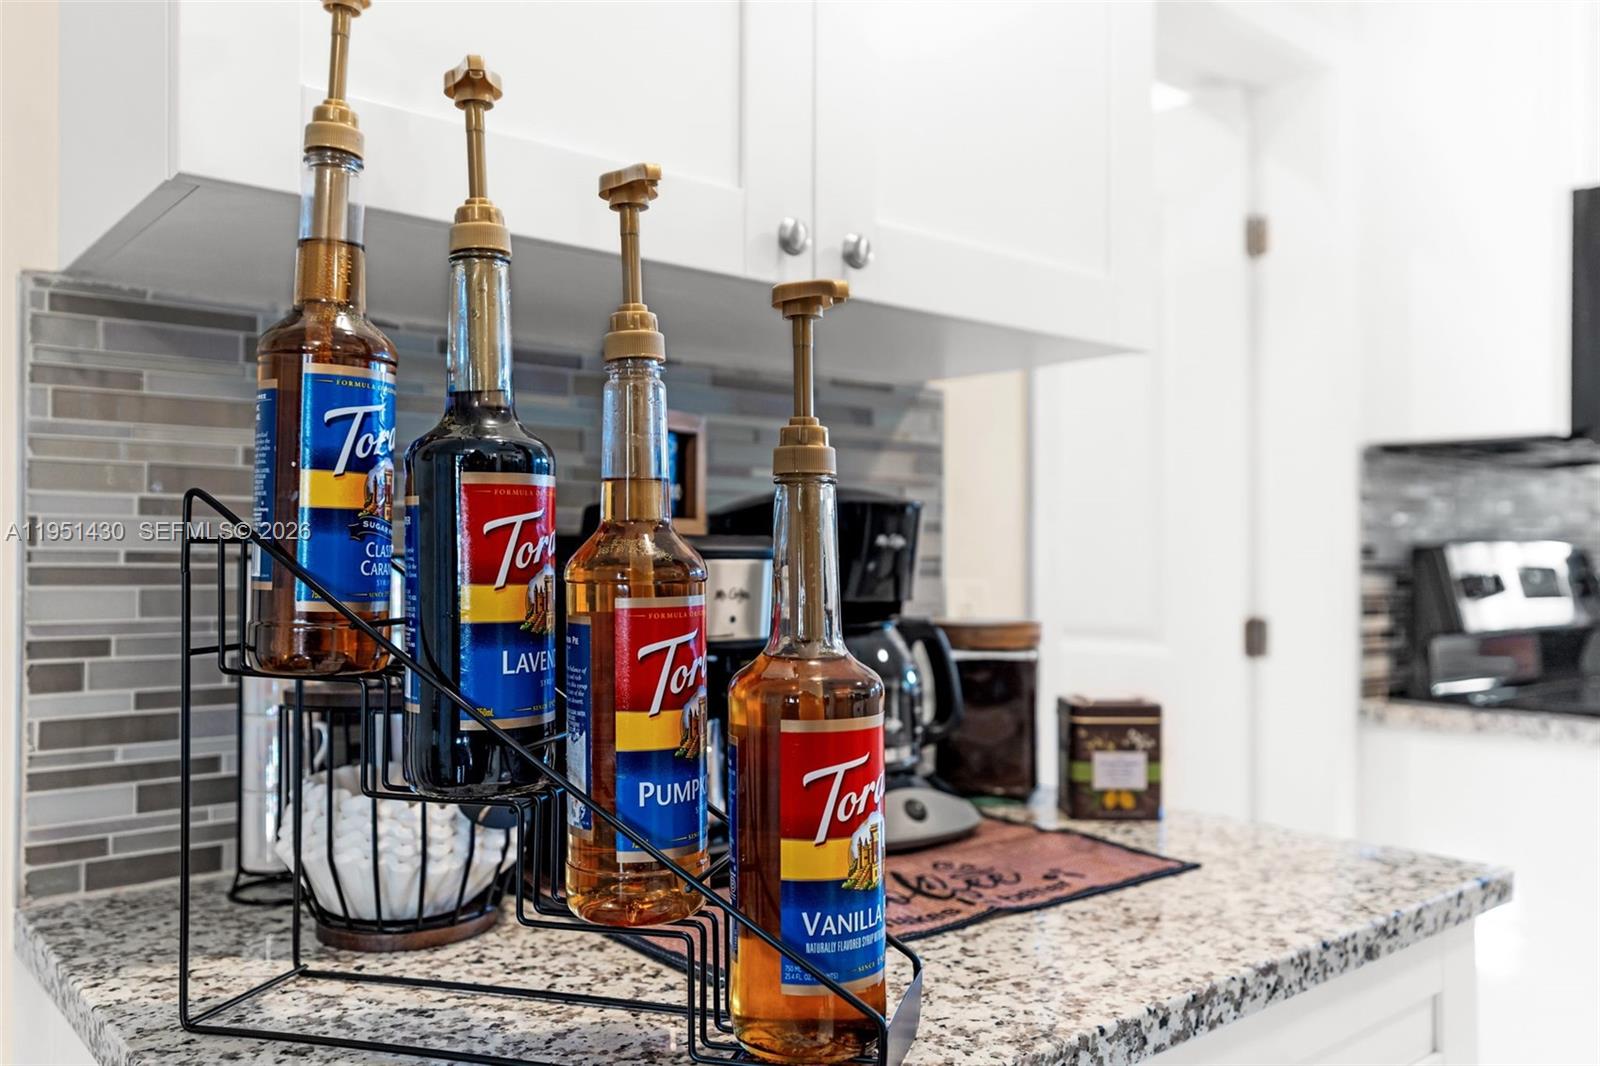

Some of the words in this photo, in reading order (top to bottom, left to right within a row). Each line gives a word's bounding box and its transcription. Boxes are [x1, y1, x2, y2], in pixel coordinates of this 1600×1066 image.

[801, 903, 883, 937] VANILLA
[805, 942, 837, 954] NATURALLY
[838, 937, 862, 952] FLAVORED
